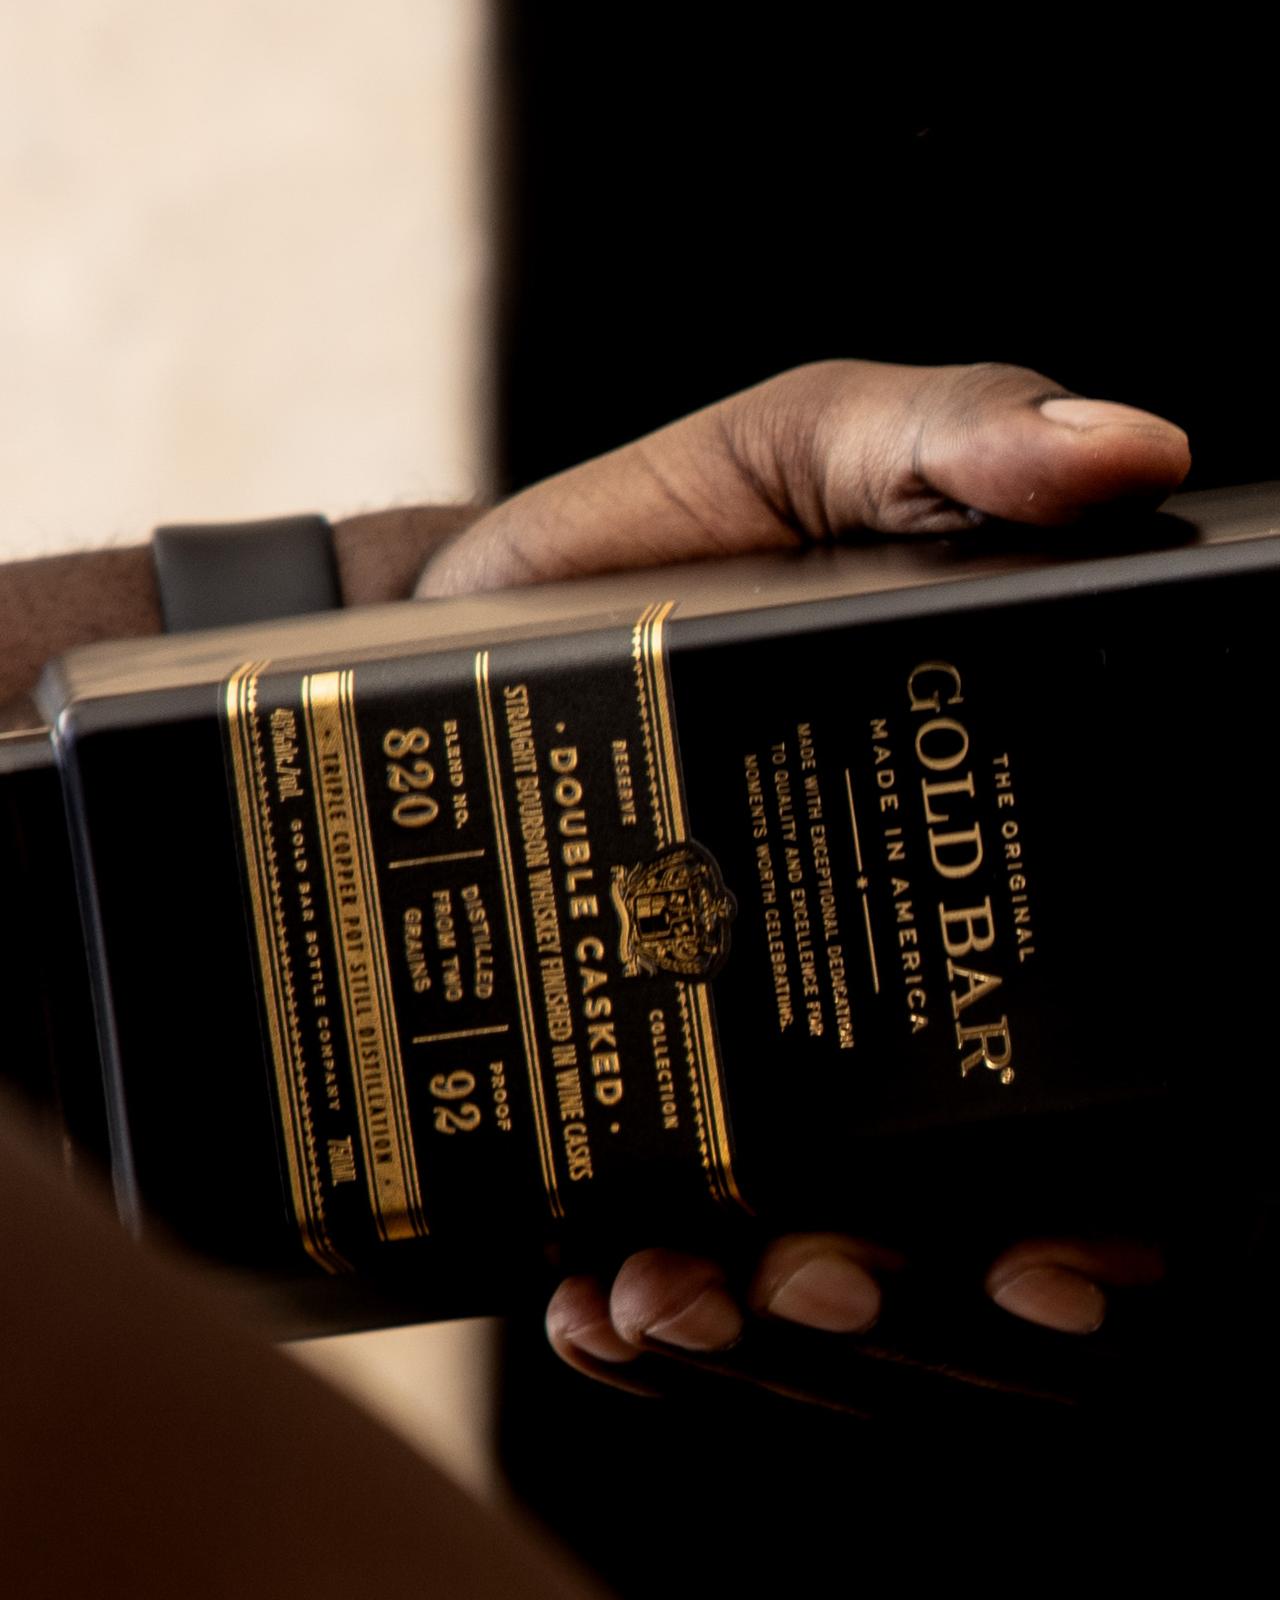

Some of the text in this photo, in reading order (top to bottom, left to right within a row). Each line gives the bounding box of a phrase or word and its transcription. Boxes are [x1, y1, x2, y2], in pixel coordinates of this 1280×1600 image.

[383, 727, 439, 827] 820
[443, 720, 469, 830] BLEND NO.
[612, 740, 637, 825] RESERVE
[745, 754, 768, 839] MOMENTS
[908, 664, 984, 879] GOLD
[756, 843, 776, 904] WORTH
[772, 741, 824, 1036] TO QUALITY AND EXCELLENCE FOR
[797, 723, 854, 1049] MADE WITH EXCEPTIONAL DEDICATION
[870, 719, 928, 1033] MADE IN AMERICA
[993, 753, 1035, 962] THE ORIGINAL
[290, 819, 341, 1110] GOLD BAR BOTTLE COMPANY
[321, 749, 393, 1166] TRIPLE COPPER POT STILL DISTILLATION
[404, 907, 432, 993] GRAINS
[432, 890, 464, 1002] FROM TWO
[461, 884, 494, 999] DISTILLED
[504, 684, 593, 1181] STRAIGHT BOURBON WHISKEY FINISHED IN WINE CASKS
[550, 746, 624, 1105] DOUBLE CASKED
[429, 1070, 482, 1134] 92
[489, 1061, 512, 1131] PROOF
[649, 1009, 679, 1129] COLLECTION
